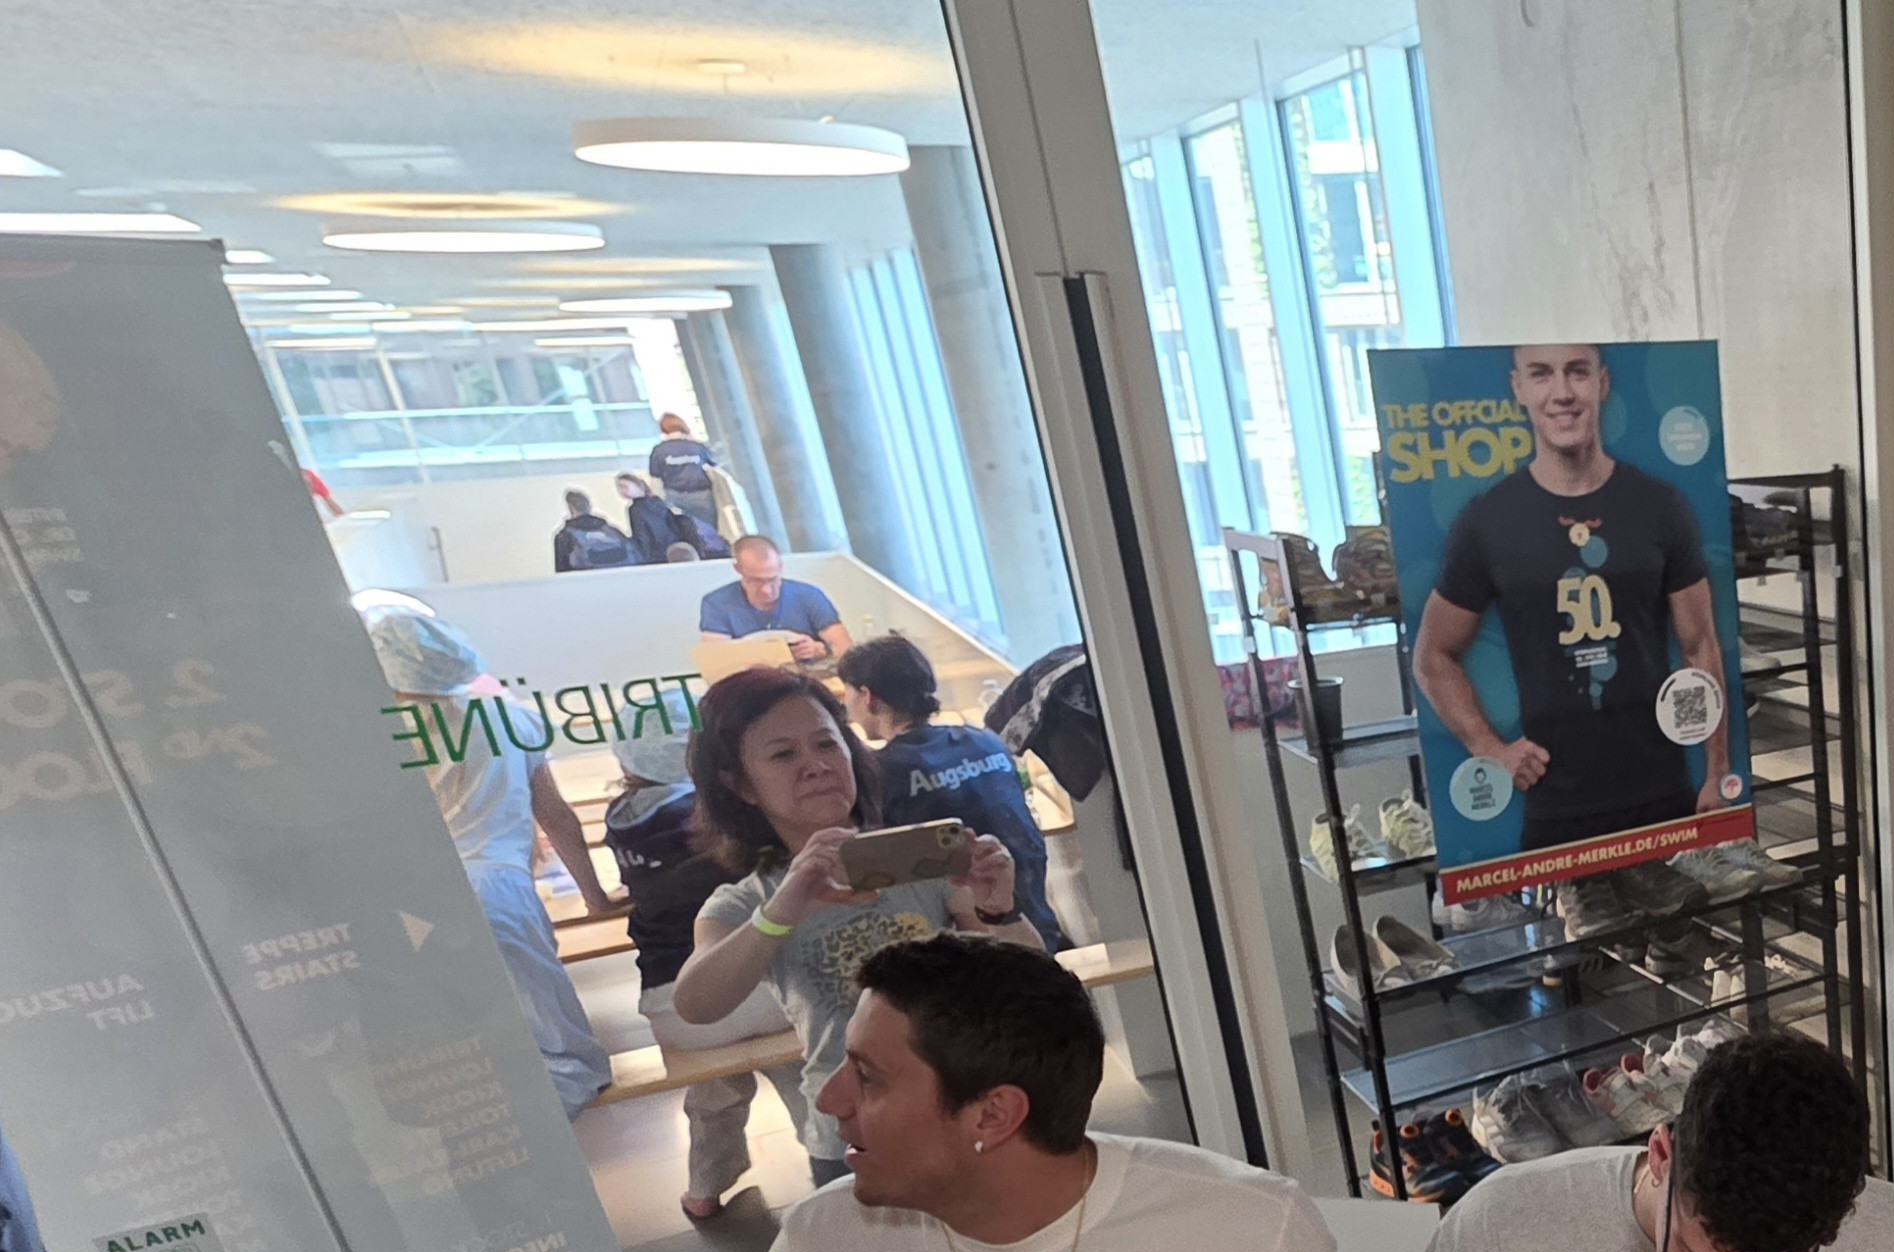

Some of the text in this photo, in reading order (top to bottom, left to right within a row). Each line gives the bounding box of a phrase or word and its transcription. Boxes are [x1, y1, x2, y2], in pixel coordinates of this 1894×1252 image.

[1383, 403, 1430, 428] THE
[1388, 426, 1533, 484] SHOP
[909, 752, 1012, 797] Augsburg
[1456, 826, 1699, 894] MARCEL-ANDRE-MERKLE.DE/SWIM
